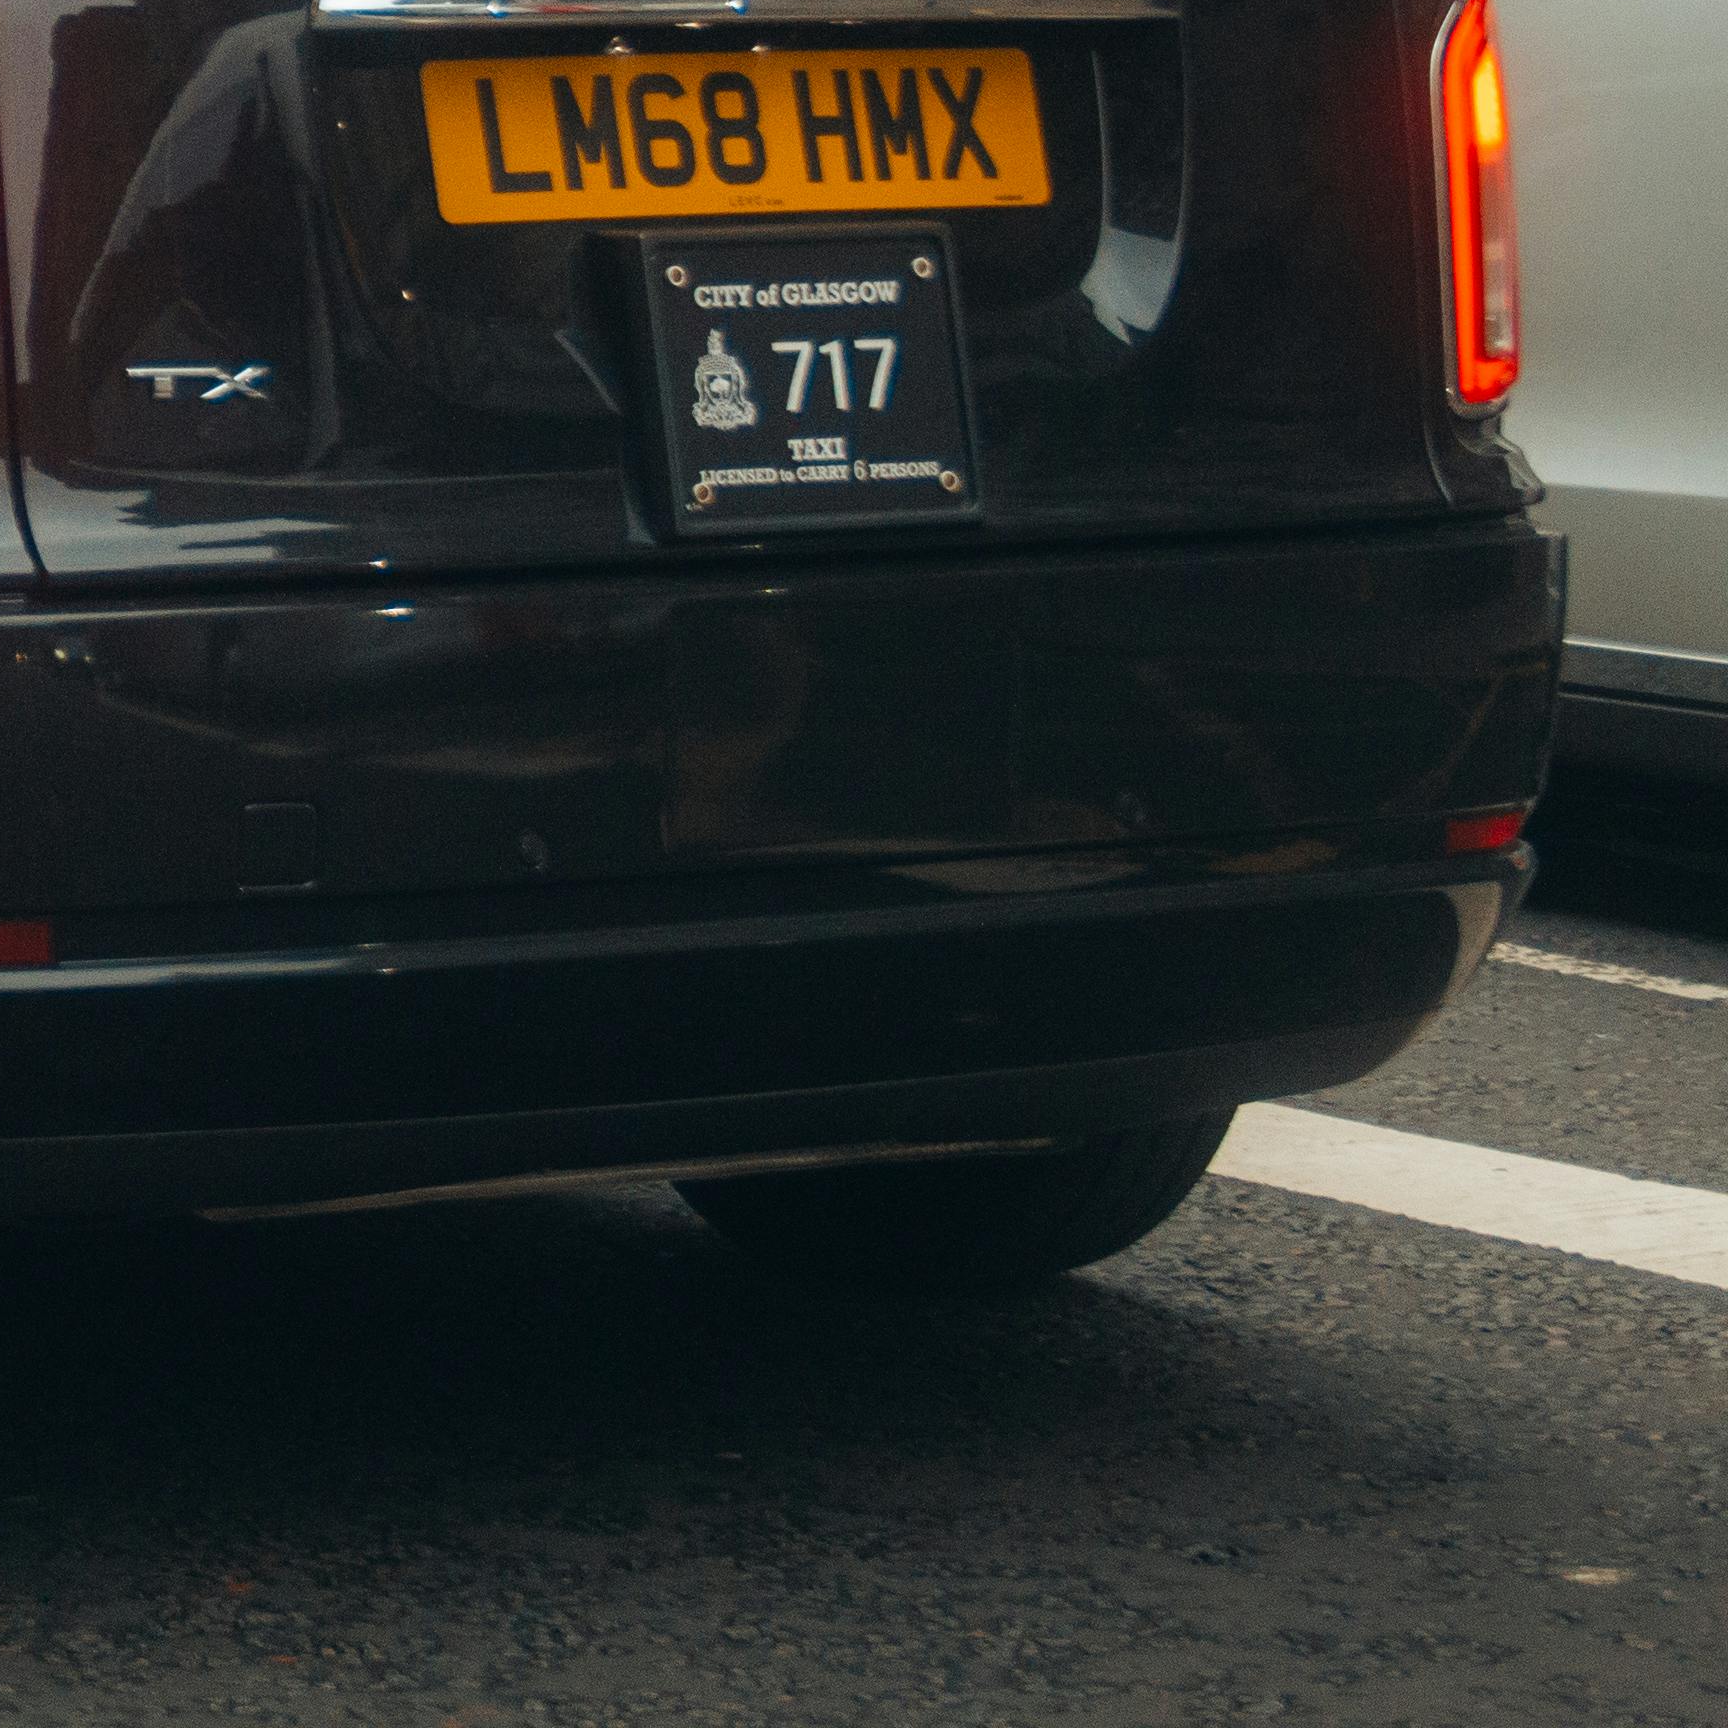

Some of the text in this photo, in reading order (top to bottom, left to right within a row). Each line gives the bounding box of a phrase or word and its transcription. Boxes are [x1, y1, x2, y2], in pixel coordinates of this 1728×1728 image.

[474, 68, 1001, 193] LM68 HMX
[694, 280, 901, 308] CITY of GLASGOW
[126, 366, 270, 400] TX
[770, 338, 897, 413] 717
[787, 436, 847, 461] TAXI
[699, 459, 942, 485] LICENSED to CARRY 6 PERSONS
